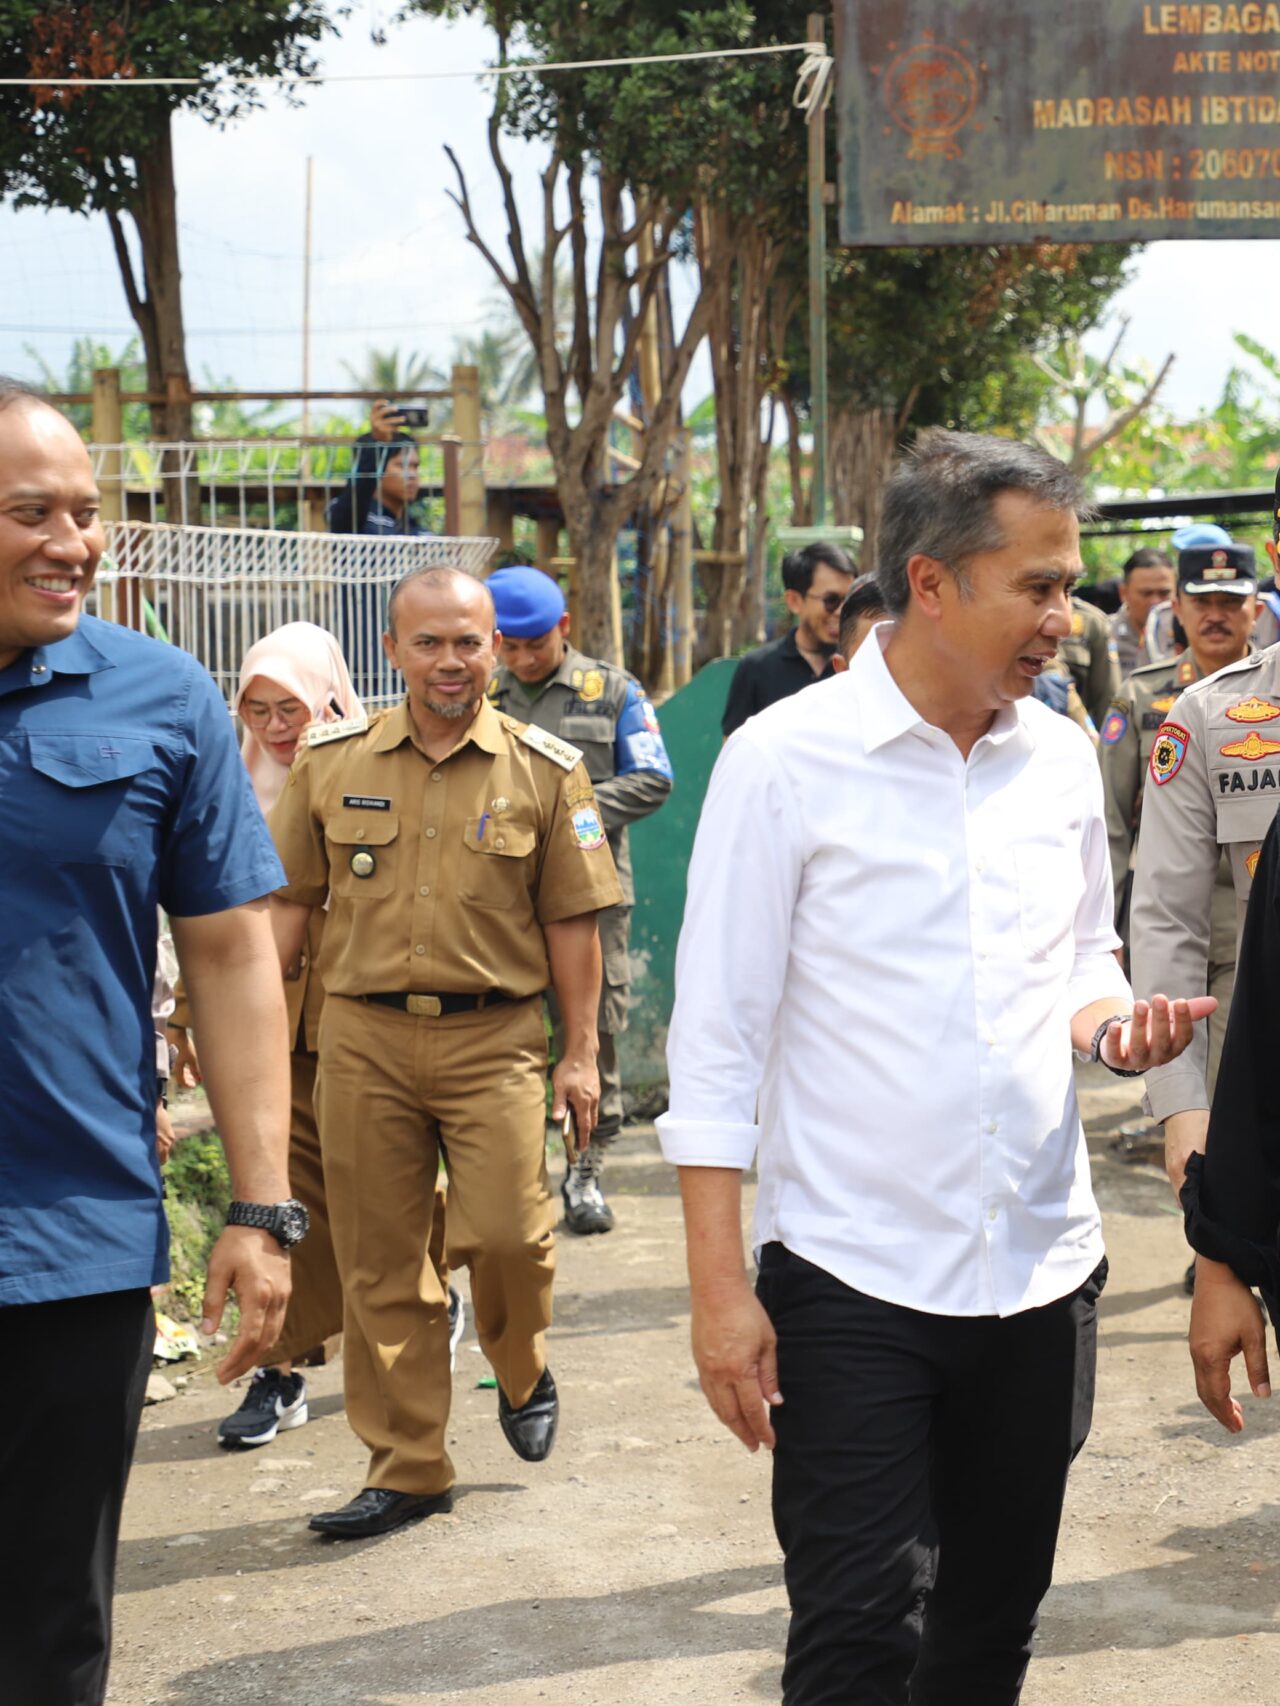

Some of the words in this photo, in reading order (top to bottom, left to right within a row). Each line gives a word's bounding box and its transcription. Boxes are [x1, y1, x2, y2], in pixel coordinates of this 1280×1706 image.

[1173, 50, 1232, 73] AKTE
[1033, 95, 1192, 129] MADRASAH
[1103, 149, 1165, 181] NSN
[890, 200, 966, 225] Alamat
